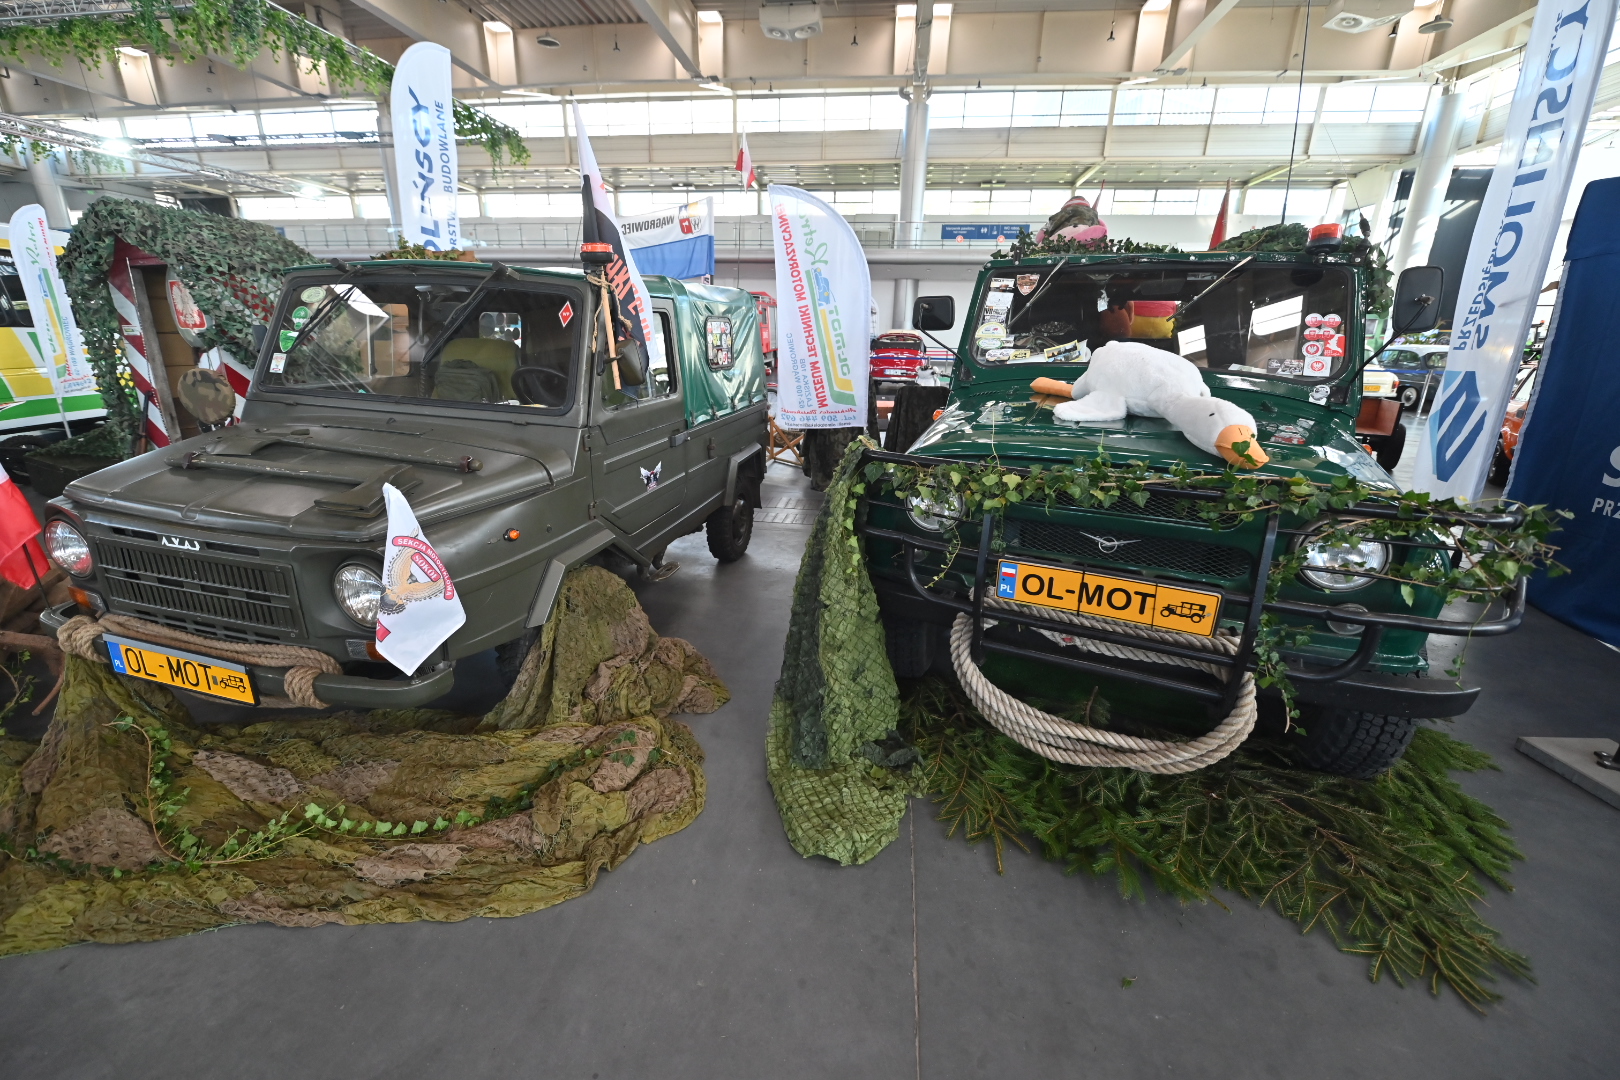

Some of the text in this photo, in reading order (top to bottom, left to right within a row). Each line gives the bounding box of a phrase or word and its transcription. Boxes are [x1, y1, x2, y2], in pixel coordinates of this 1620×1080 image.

[434, 99, 454, 194] BUDOWLANE
[397, 537, 454, 597] SEKCJA MOTOCYKLOWA
[1000, 583, 1014, 594] PL
[1021, 573, 1156, 616] OL-MOT
[114, 659, 124, 668] PL
